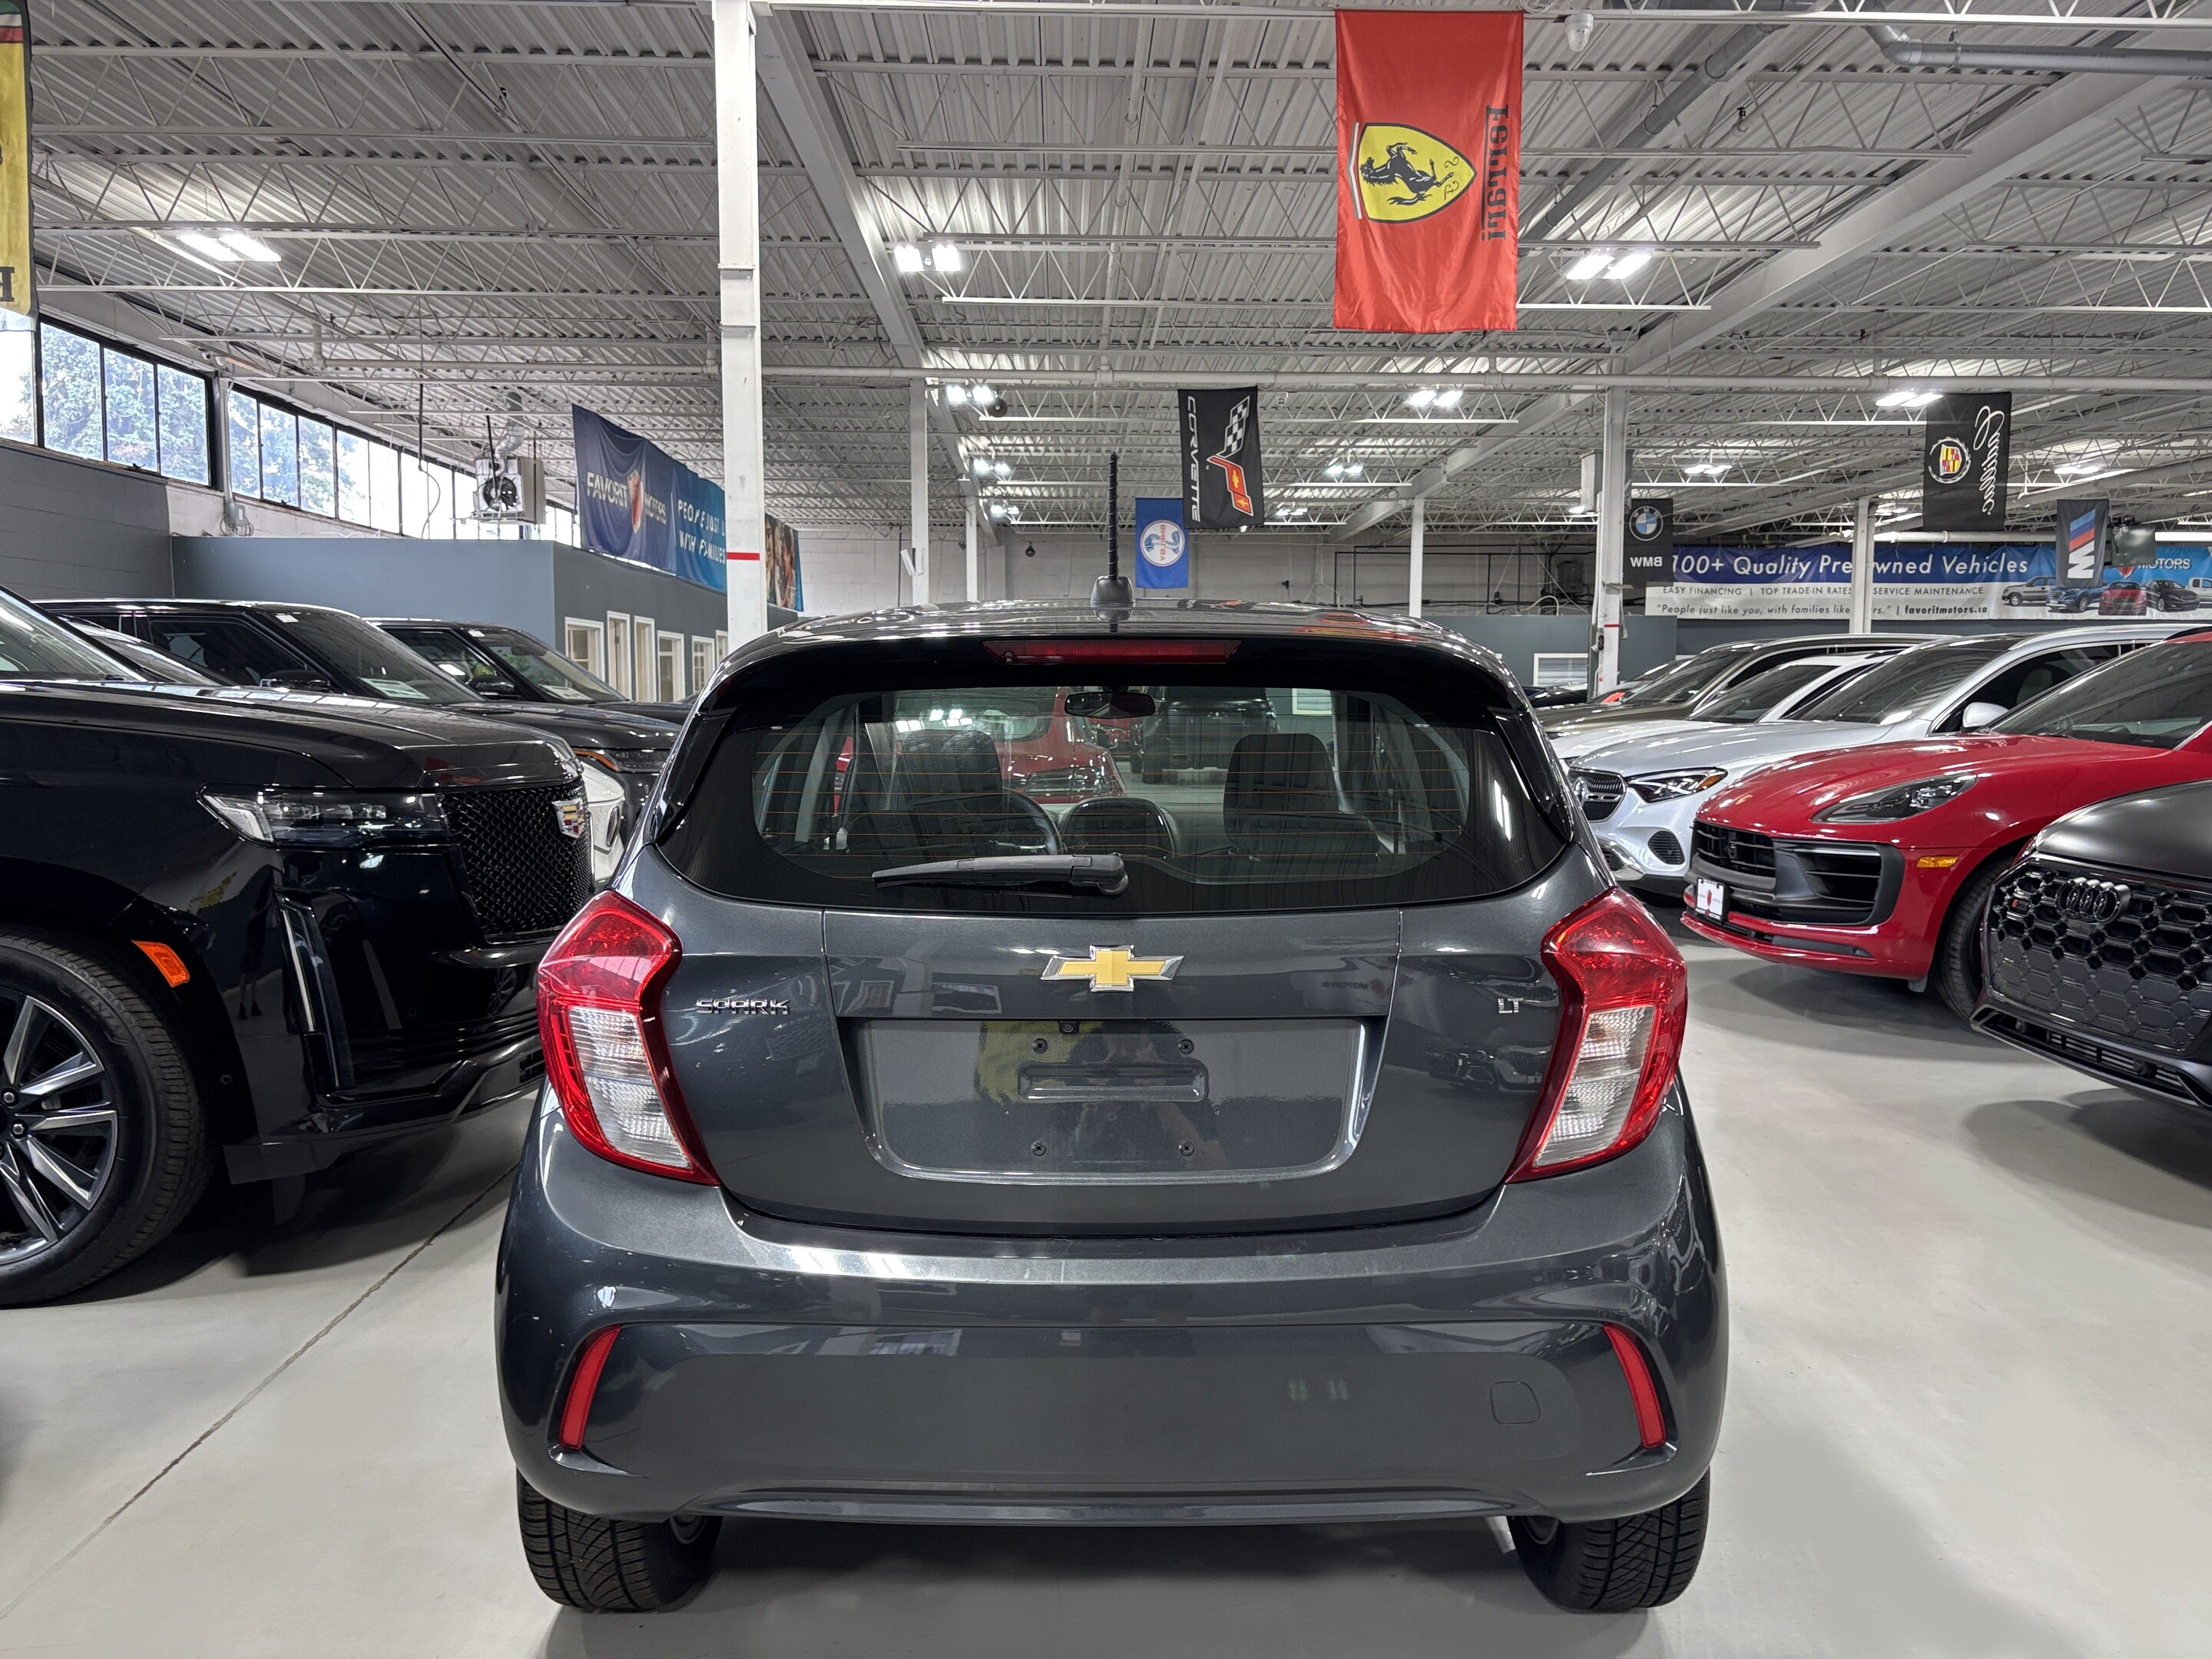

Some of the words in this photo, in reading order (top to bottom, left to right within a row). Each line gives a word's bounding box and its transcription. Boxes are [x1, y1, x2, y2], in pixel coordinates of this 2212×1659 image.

[1187, 396, 1201, 523] CORVETTE
[587, 472, 628, 508] FAVORIT
[677, 499, 706, 528] PEOE
[679, 530, 697, 554] WITH
[1733, 555, 1812, 579] Quality
[1873, 553, 1933, 575] wned
[1941, 552, 2028, 575] Vehicles
[1663, 586, 1686, 594] EASY
[1690, 588, 1742, 596] FINANCING
[1782, 587, 1823, 595] TRADE-IN
[1873, 587, 1909, 596] SERVICE
[1914, 587, 1984, 596] MAINTENANCE
[1699, 604, 1718, 615] just
[1721, 604, 1739, 614] like
[1743, 607, 1763, 616] you,
[1767, 604, 1787, 614] with
[1791, 604, 1830, 614] families
[1833, 604, 1851, 614] like
[1905, 604, 1988, 614] favoritmotors.ca
[696, 998, 790, 1015] SPARK
[1498, 998, 1524, 1014] LT
